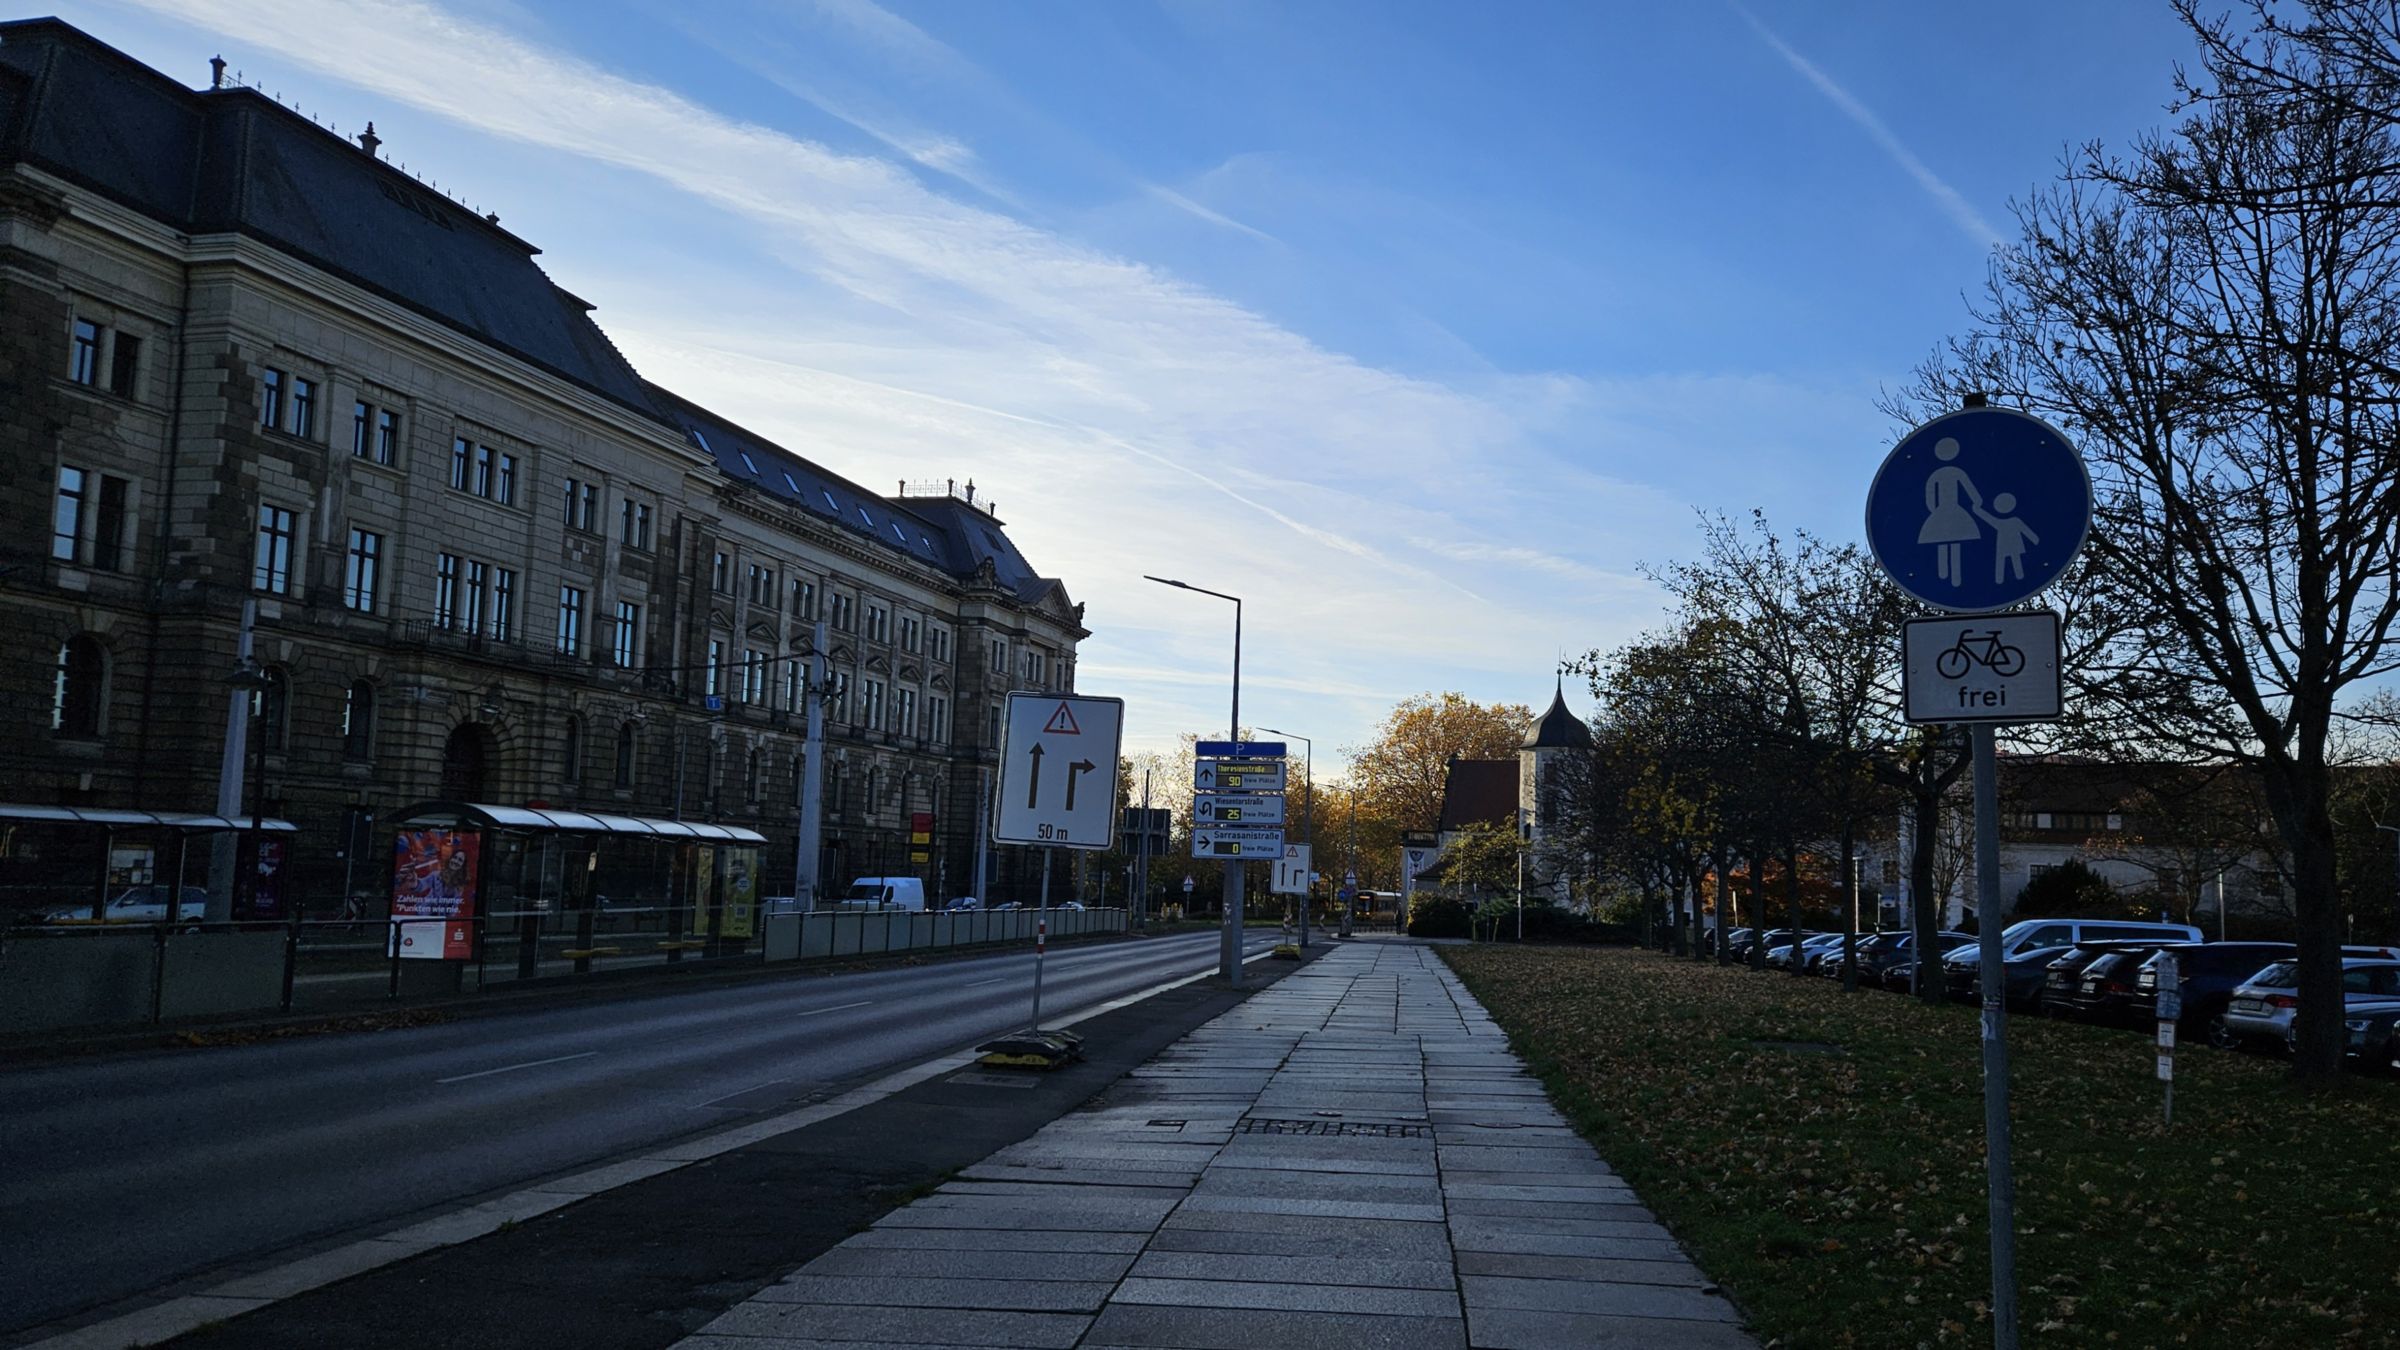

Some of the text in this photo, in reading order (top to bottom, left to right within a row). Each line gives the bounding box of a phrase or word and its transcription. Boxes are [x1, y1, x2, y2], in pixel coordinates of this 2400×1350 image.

[1959, 685, 2006, 707] frei
[1236, 743, 1245, 755] P
[1228, 776, 1241, 787] 90
[1227, 809, 1240, 819] 25
[1038, 823, 1068, 840] 50 m
[1214, 830, 1280, 840] Sarrasanistraße
[1231, 843, 1240, 854] 0
[396, 894, 423, 903] Zahlen
[424, 896, 438, 904] wie
[432, 905, 445, 913] wie
